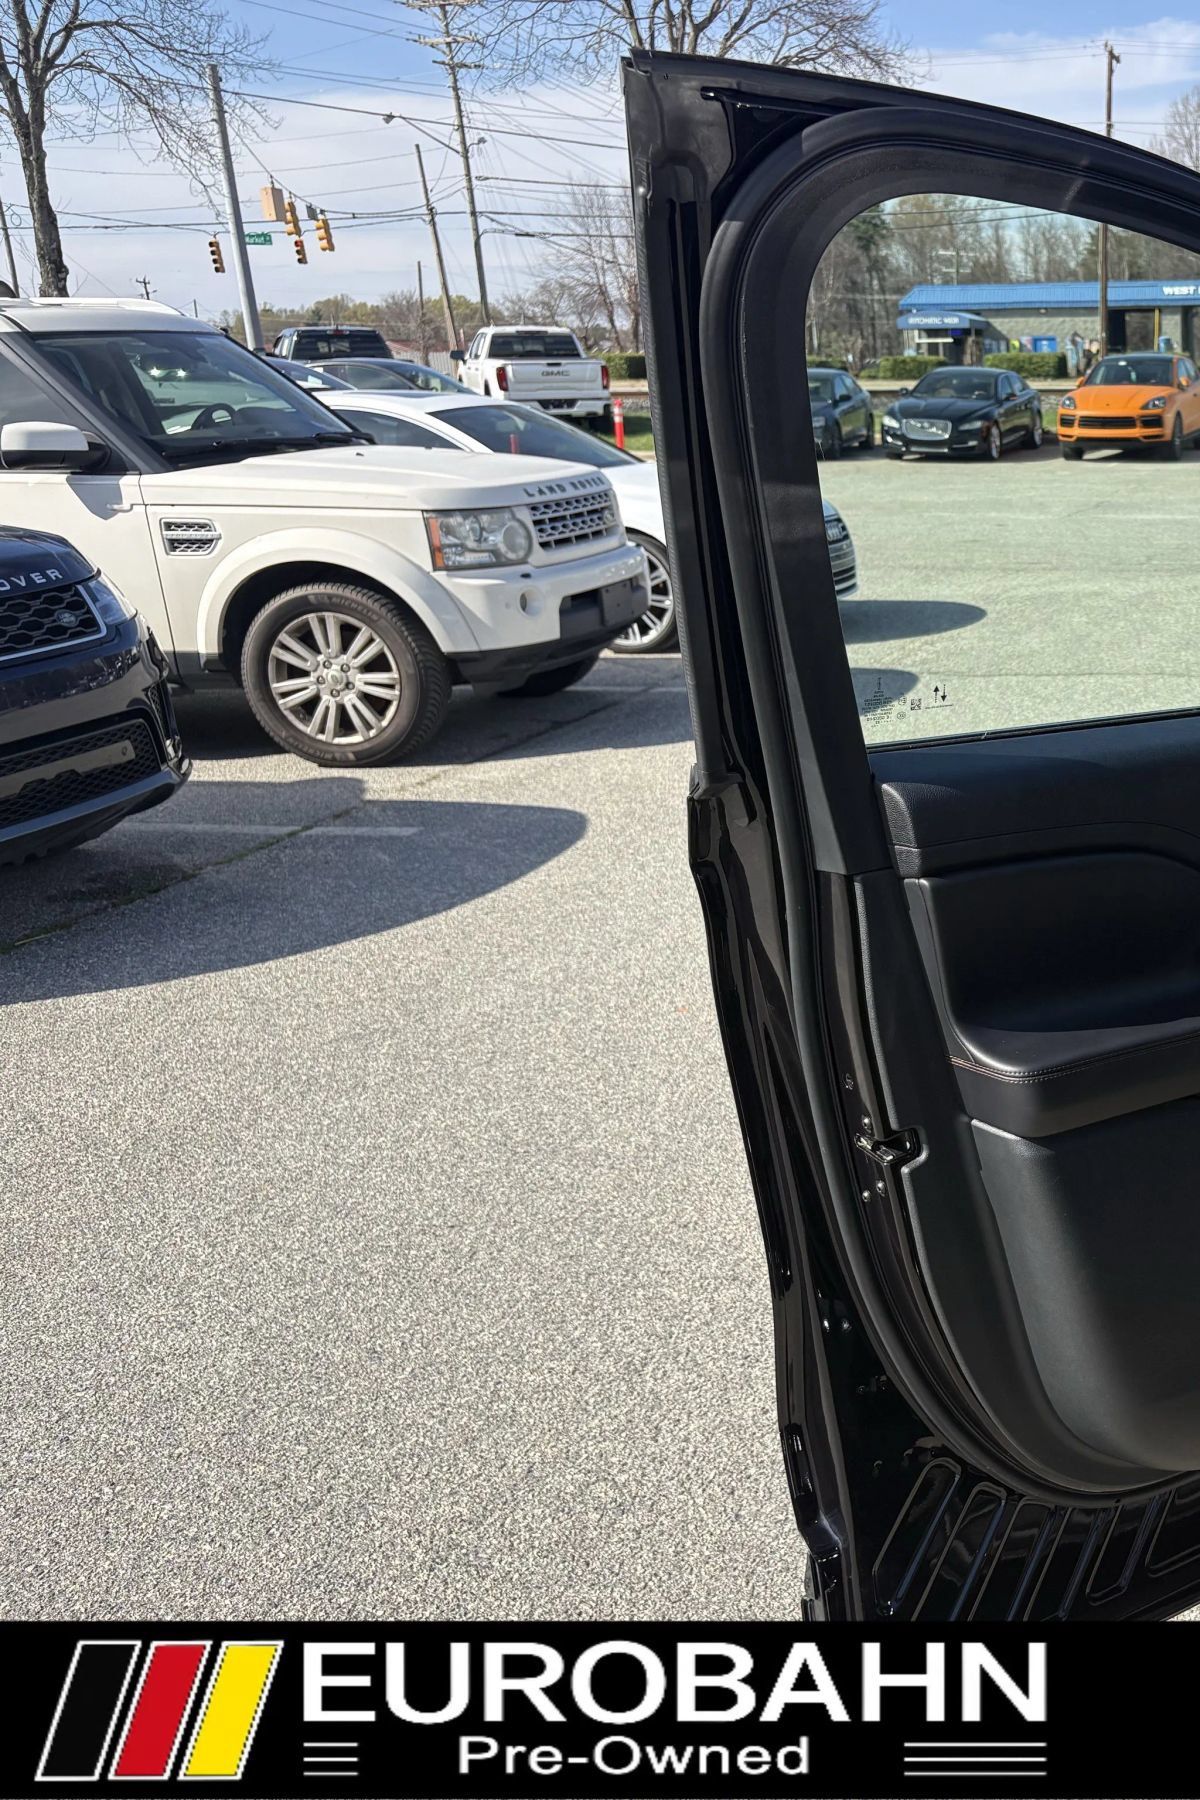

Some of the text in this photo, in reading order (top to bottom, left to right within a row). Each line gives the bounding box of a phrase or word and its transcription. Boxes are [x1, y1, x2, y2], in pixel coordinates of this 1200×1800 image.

[1162, 286, 1197, 295] WEST
[522, 483, 567, 498] LAND
[0, 568, 63, 591] OVER
